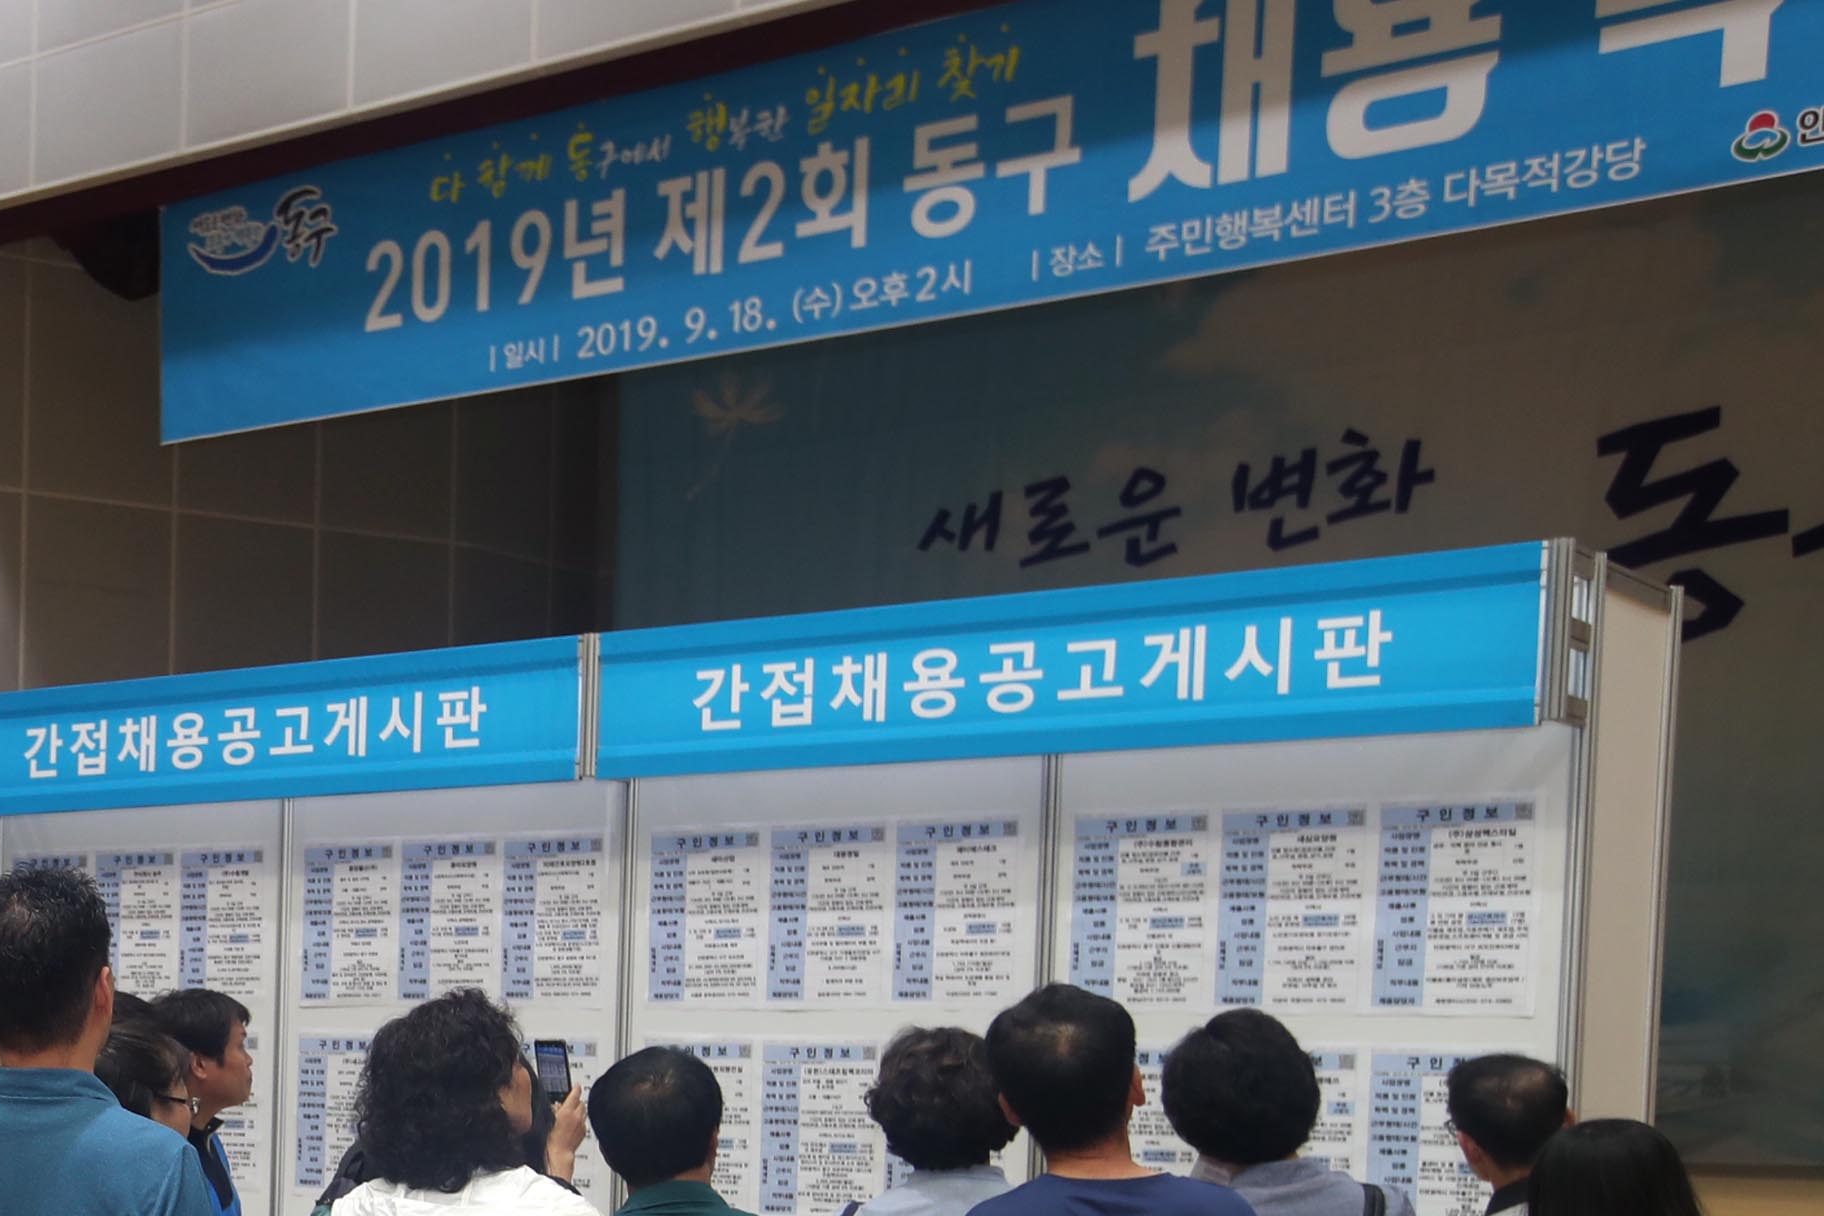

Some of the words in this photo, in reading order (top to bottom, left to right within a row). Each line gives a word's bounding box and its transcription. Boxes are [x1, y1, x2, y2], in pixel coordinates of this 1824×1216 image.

[806, 71, 919, 134] 일자리
[939, 45, 1020, 100] 찾기
[364, 190, 627, 332] 2019년
[653, 137, 870, 276] 제2회
[902, 95, 1082, 239] 동구
[1128, 0, 1502, 202] 채용
[1144, 190, 1357, 262] 주민행복센터
[1368, 178, 1430, 225] 3층
[1443, 138, 1648, 207] 다목적강당
[577, 317, 669, 360] 2019.
[684, 308, 718, 343] 9.
[728, 297, 777, 333] 18.
[917, 467, 1182, 568] 새로운
[1232, 428, 1435, 551] 변화
[1597, 405, 1824, 643] 동
[24, 686, 487, 779] 간접채용공고게시판
[692, 610, 1394, 733] 간접채용공고게시판
